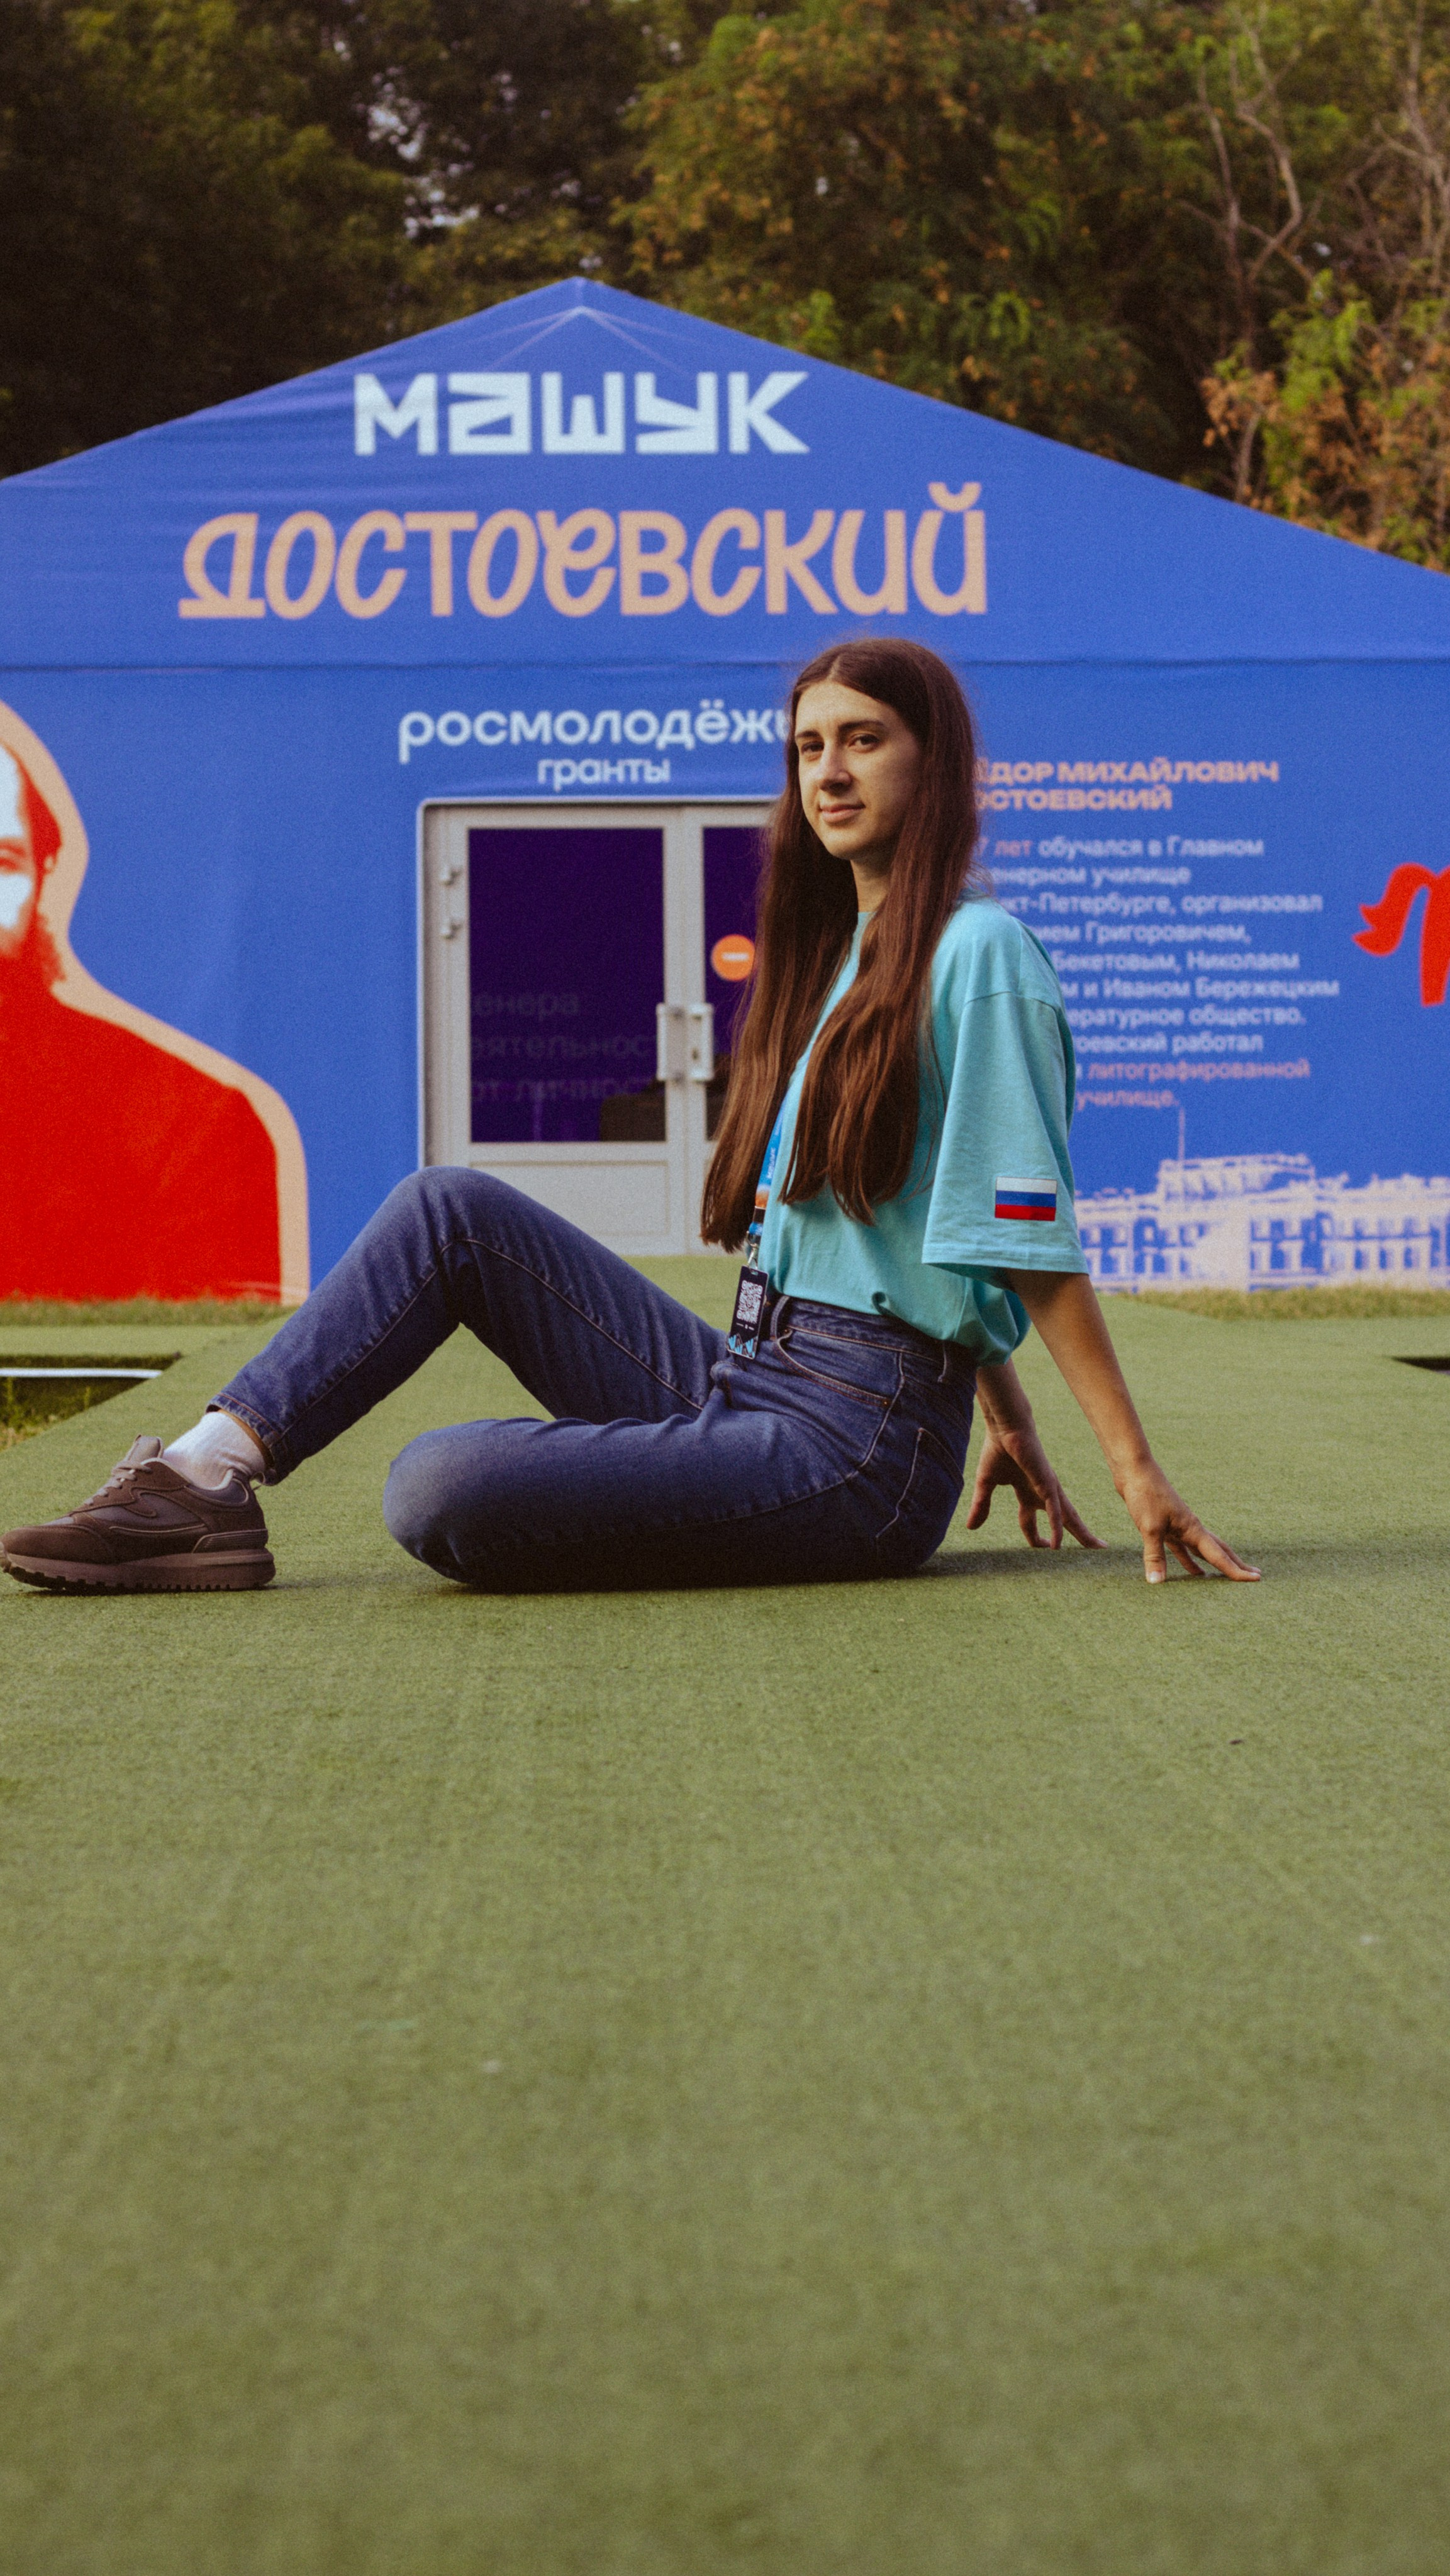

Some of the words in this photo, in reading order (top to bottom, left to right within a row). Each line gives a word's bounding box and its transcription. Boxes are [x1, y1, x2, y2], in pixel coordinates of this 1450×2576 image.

[178, 482, 987, 619] ДОСТОЕВСКИЙ
[538, 758, 671, 791] гранты
[975, 757, 1054, 786] ДОР
[1056, 757, 1280, 783] МИХАЙЛОВИЧ
[975, 784, 1173, 811] ОСТОЕВСКИЙ
[995, 840, 1032, 857] лет
[1039, 836, 1143, 860] обучался
[1148, 839, 1162, 856] в
[1168, 836, 1264, 856] Главном
[991, 867, 1086, 887] енерном
[1092, 867, 1191, 887] училище
[1001, 892, 1176, 917] кт-Петербурге,
[1182, 896, 1322, 918] организовал
[1086, 921, 1251, 945] Григоровичем,
[1187, 950, 1299, 970] Николаем
[1084, 982, 1098, 997] и
[1104, 977, 1190, 998] Иваном
[1068, 1008, 1184, 1030] ературное
[1189, 1004, 1304, 1028] общество.
[1074, 1031, 1167, 1053] оевский
[1173, 1031, 1263, 1056] работал
[1088, 1059, 1310, 1083] литографированной
[1077, 1090, 1179, 1111] училище.
